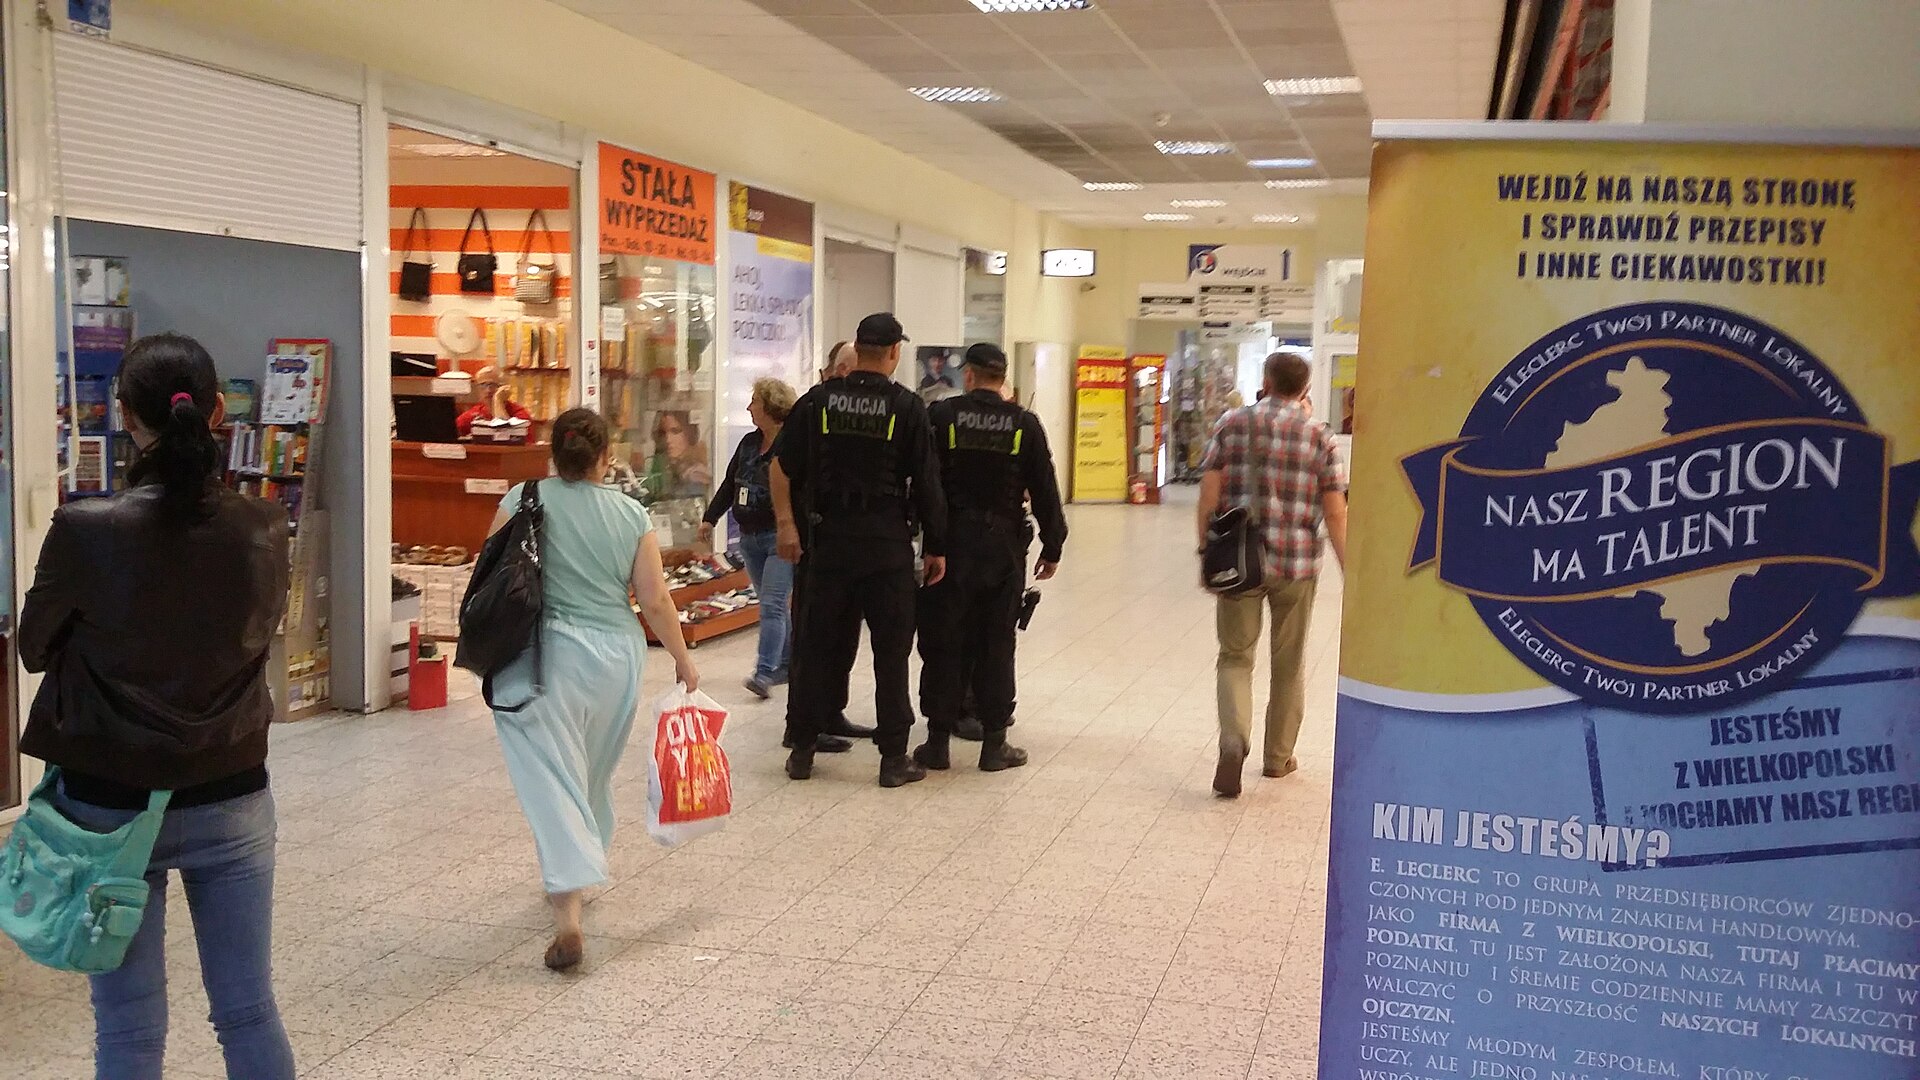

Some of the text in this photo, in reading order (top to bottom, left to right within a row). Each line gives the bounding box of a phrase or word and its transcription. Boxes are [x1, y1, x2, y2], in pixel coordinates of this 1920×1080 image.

[622, 158, 696, 210] STAŁA
[1498, 171, 1857, 213] WEJDŹ NA NASZĄ STRONĘ
[605, 197, 708, 242] WYPRZEDAŻ
[1522, 211, 1827, 246] I SPRAWDŹ PRZEPISY
[1517, 251, 1827, 285] I INNE CIEKAWOSTKI!
[1660, 310, 1756, 347] PARTNER
[1762, 336, 1848, 417] LOKALNY
[827, 393, 888, 417] POLICJA
[957, 411, 1014, 432] POLICJA
[1483, 436, 1848, 528] NASZ REGION
[1531, 503, 1769, 583] MA TALENT
[1582, 664, 1637, 699] TWÓJ
[1643, 680, 1734, 702] PARTNER
[1736, 627, 1820, 689] LOKALNY
[1710, 705, 1842, 747] JESTEŚMY
[1674, 744, 1896, 789] Z WIELKOPOLSKI
[1640, 795, 1774, 830] KOCHAMY
[1781, 788, 1853, 822] NASZ
[1372, 802, 1671, 867] KIM JESTEŚMY?
[1369, 881, 1860, 949] CZONYCH POD JEDNYM ZNAKIEM HANDLOWYM.
[1370, 857, 1920, 929] E. LECLERC TO GRUPA PRZEDSIĘBIORCÓW ZJEDNO-
[1366, 927, 1919, 1005] PODATKI, TU JEST ZAŁOŻONA NASZA FIRMA I TU W
[1367, 904, 1920, 980] JAKO FIRMA Z WIELKOPOLSKI, TUTAJ PŁACIMY
[1362, 998, 1455, 1024] OJCZYZN.
[1366, 951, 1919, 1032] POZNANIU I ŚREMIE CODZIENNIE MAMY ZASZCZYT
[1364, 974, 1917, 1058] WALCZYĆ O PRZYSZŁOŚĆ NASZYCH LOKALNYCH
[1360, 1045, 1413, 1067] UCZY,
[1426, 1054, 1458, 1073] ALE
[1471, 1060, 1537, 1080] JEDNO
[1361, 1022, 1450, 1047] JESTEŚMY
[1467, 1035, 1557, 1061] MŁODYM
